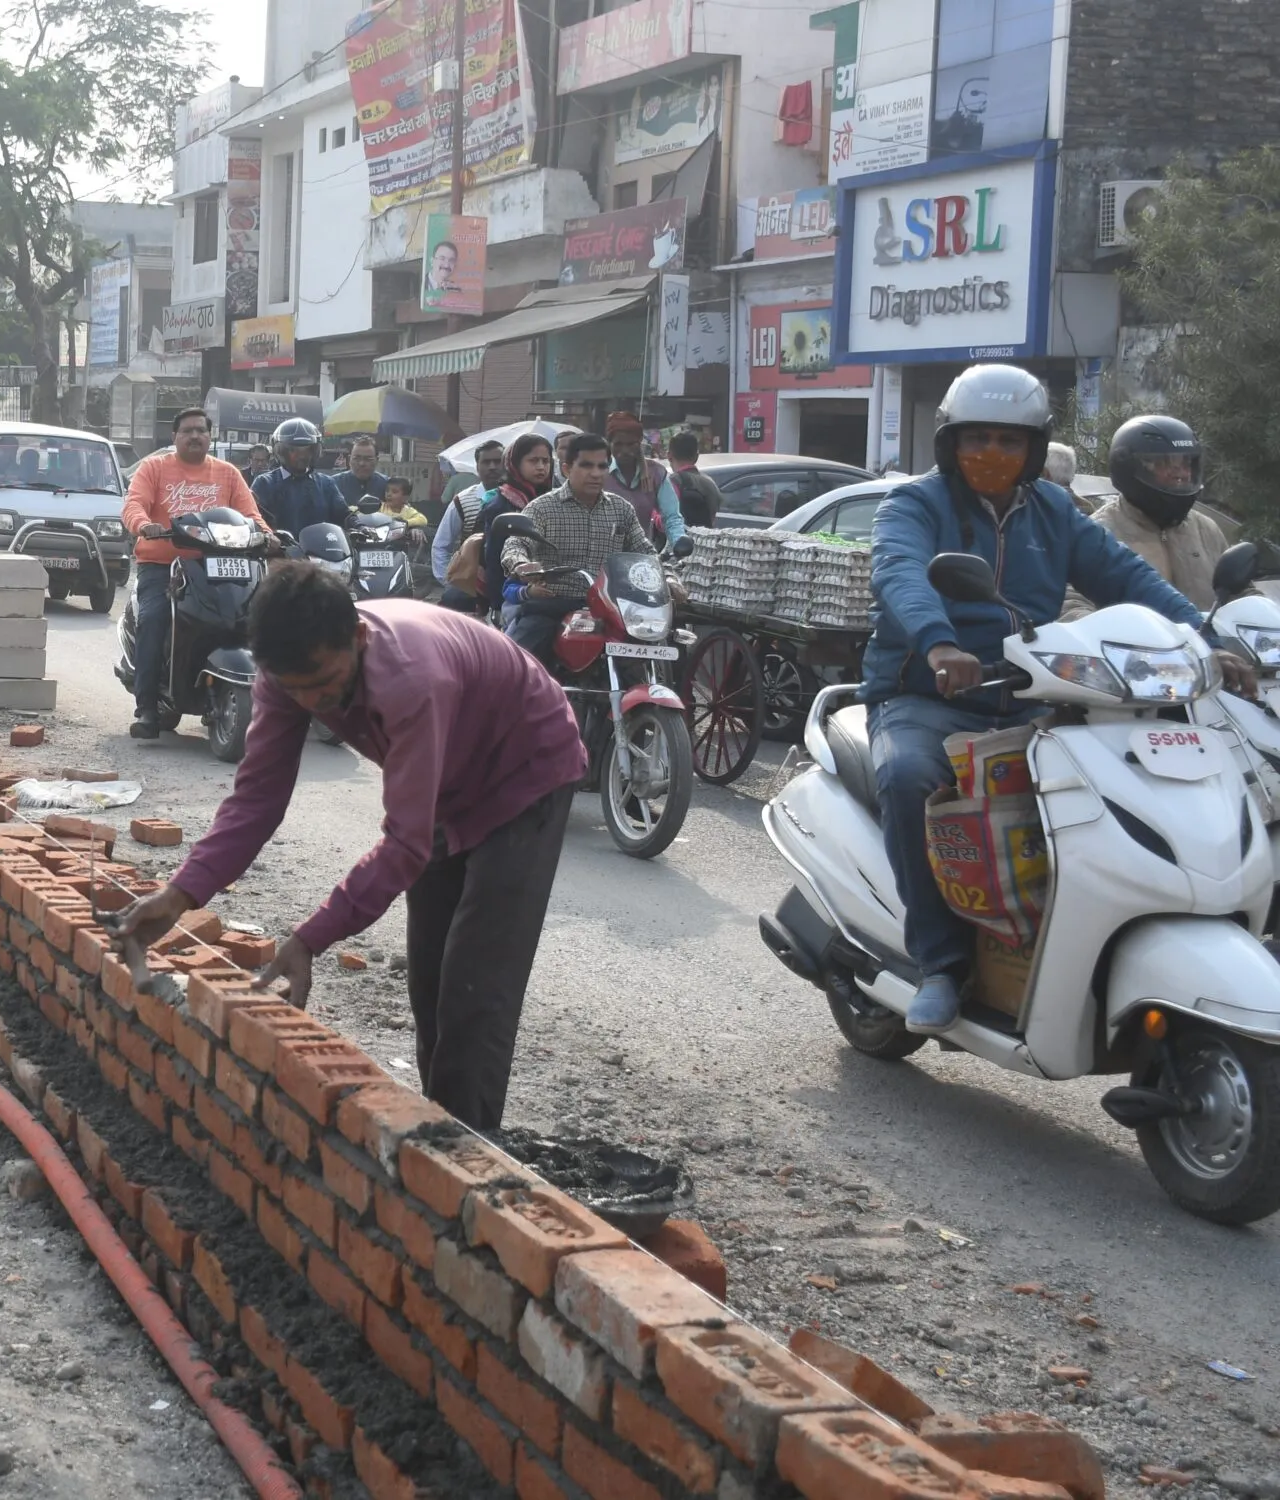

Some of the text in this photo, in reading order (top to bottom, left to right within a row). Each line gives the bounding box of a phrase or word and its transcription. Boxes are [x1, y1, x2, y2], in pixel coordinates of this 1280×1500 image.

[858, 109, 868, 121] CA
[869, 105, 890, 119] VINAY
[892, 96, 924, 115] SHARMA
[799, 199, 830, 232] LED
[902, 187, 1006, 262] SRL
[869, 275, 1011, 326] Diagnostics
[163, 304, 195, 334] Panjabi
[752, 326, 777, 367] LED
[242, 397, 298, 414] Amul
[747, 420, 761, 429] LCD
[747, 430, 761, 439] LED
[167, 498, 199, 513] Denim
[216, 559, 245, 568] UP25C
[217, 568, 246, 577] B3078
